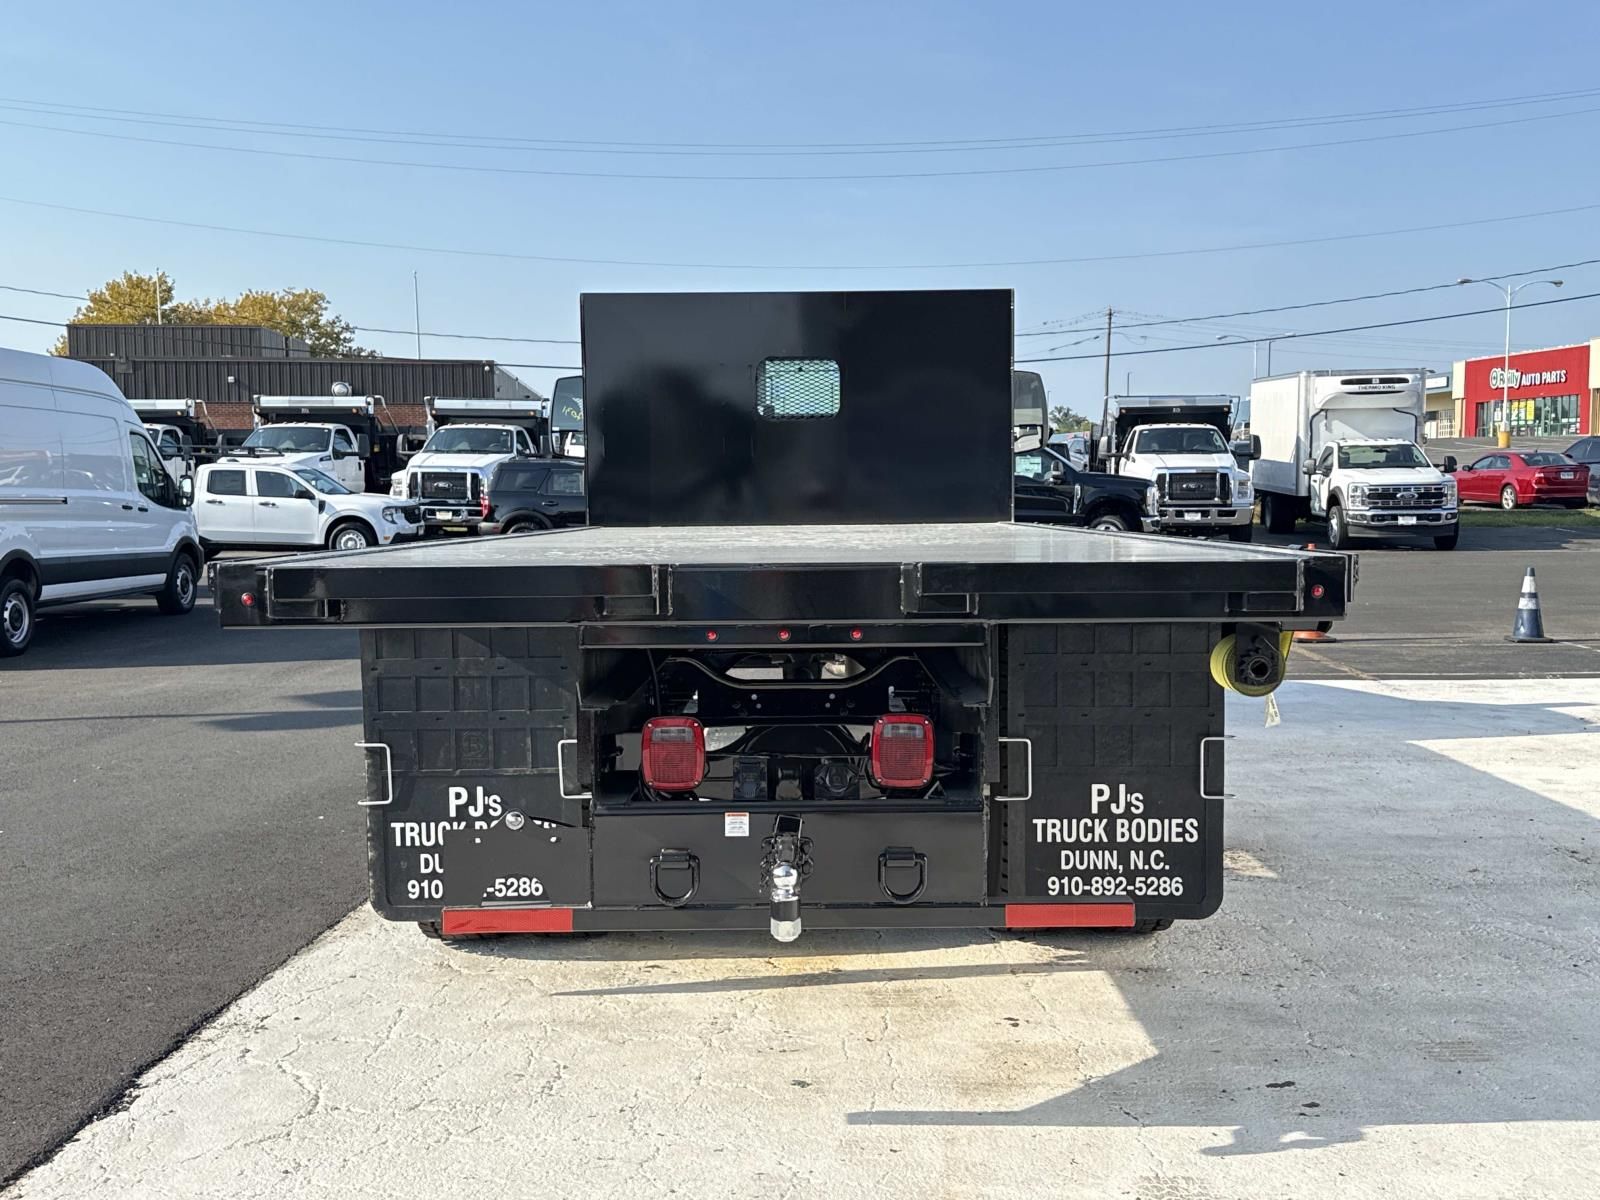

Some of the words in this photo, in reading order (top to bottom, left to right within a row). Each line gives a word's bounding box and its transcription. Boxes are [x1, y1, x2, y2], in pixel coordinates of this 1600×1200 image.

[1490, 368, 1521, 389] O'Rilly
[1521, 373, 1541, 387] AUTO
[1541, 370, 1567, 384] PARTS
[1032, 818, 1109, 843] TRUCK
[1116, 817, 1199, 843] BODIES
[1060, 850, 1123, 873] DUNN,
[1130, 850, 1170, 870] N.C.
[1047, 876, 1184, 896] 910-892-5286
